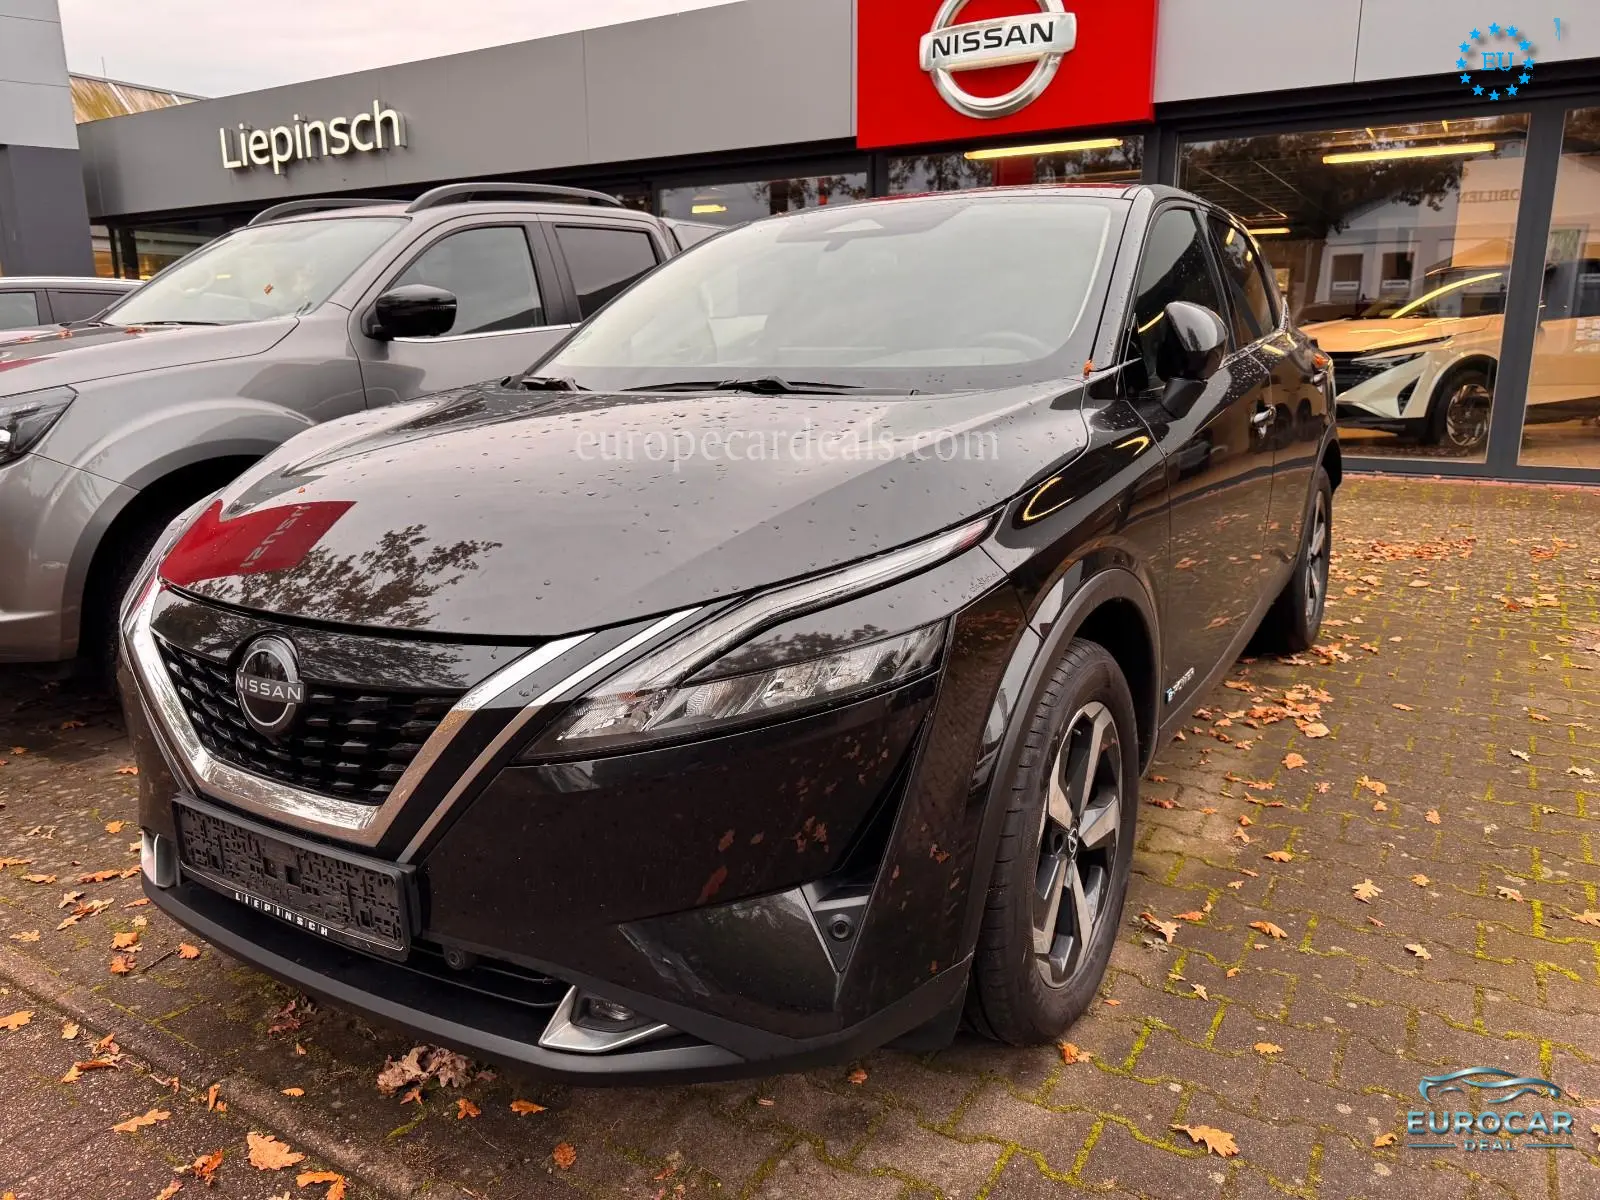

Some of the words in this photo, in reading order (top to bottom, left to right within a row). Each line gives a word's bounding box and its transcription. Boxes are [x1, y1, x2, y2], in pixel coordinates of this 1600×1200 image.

[932, 21, 1053, 59] NISSAN
[219, 99, 401, 175] Liepinsch
[236, 674, 301, 700] NISSAN
[235, 892, 328, 936] LIEPINSCH
